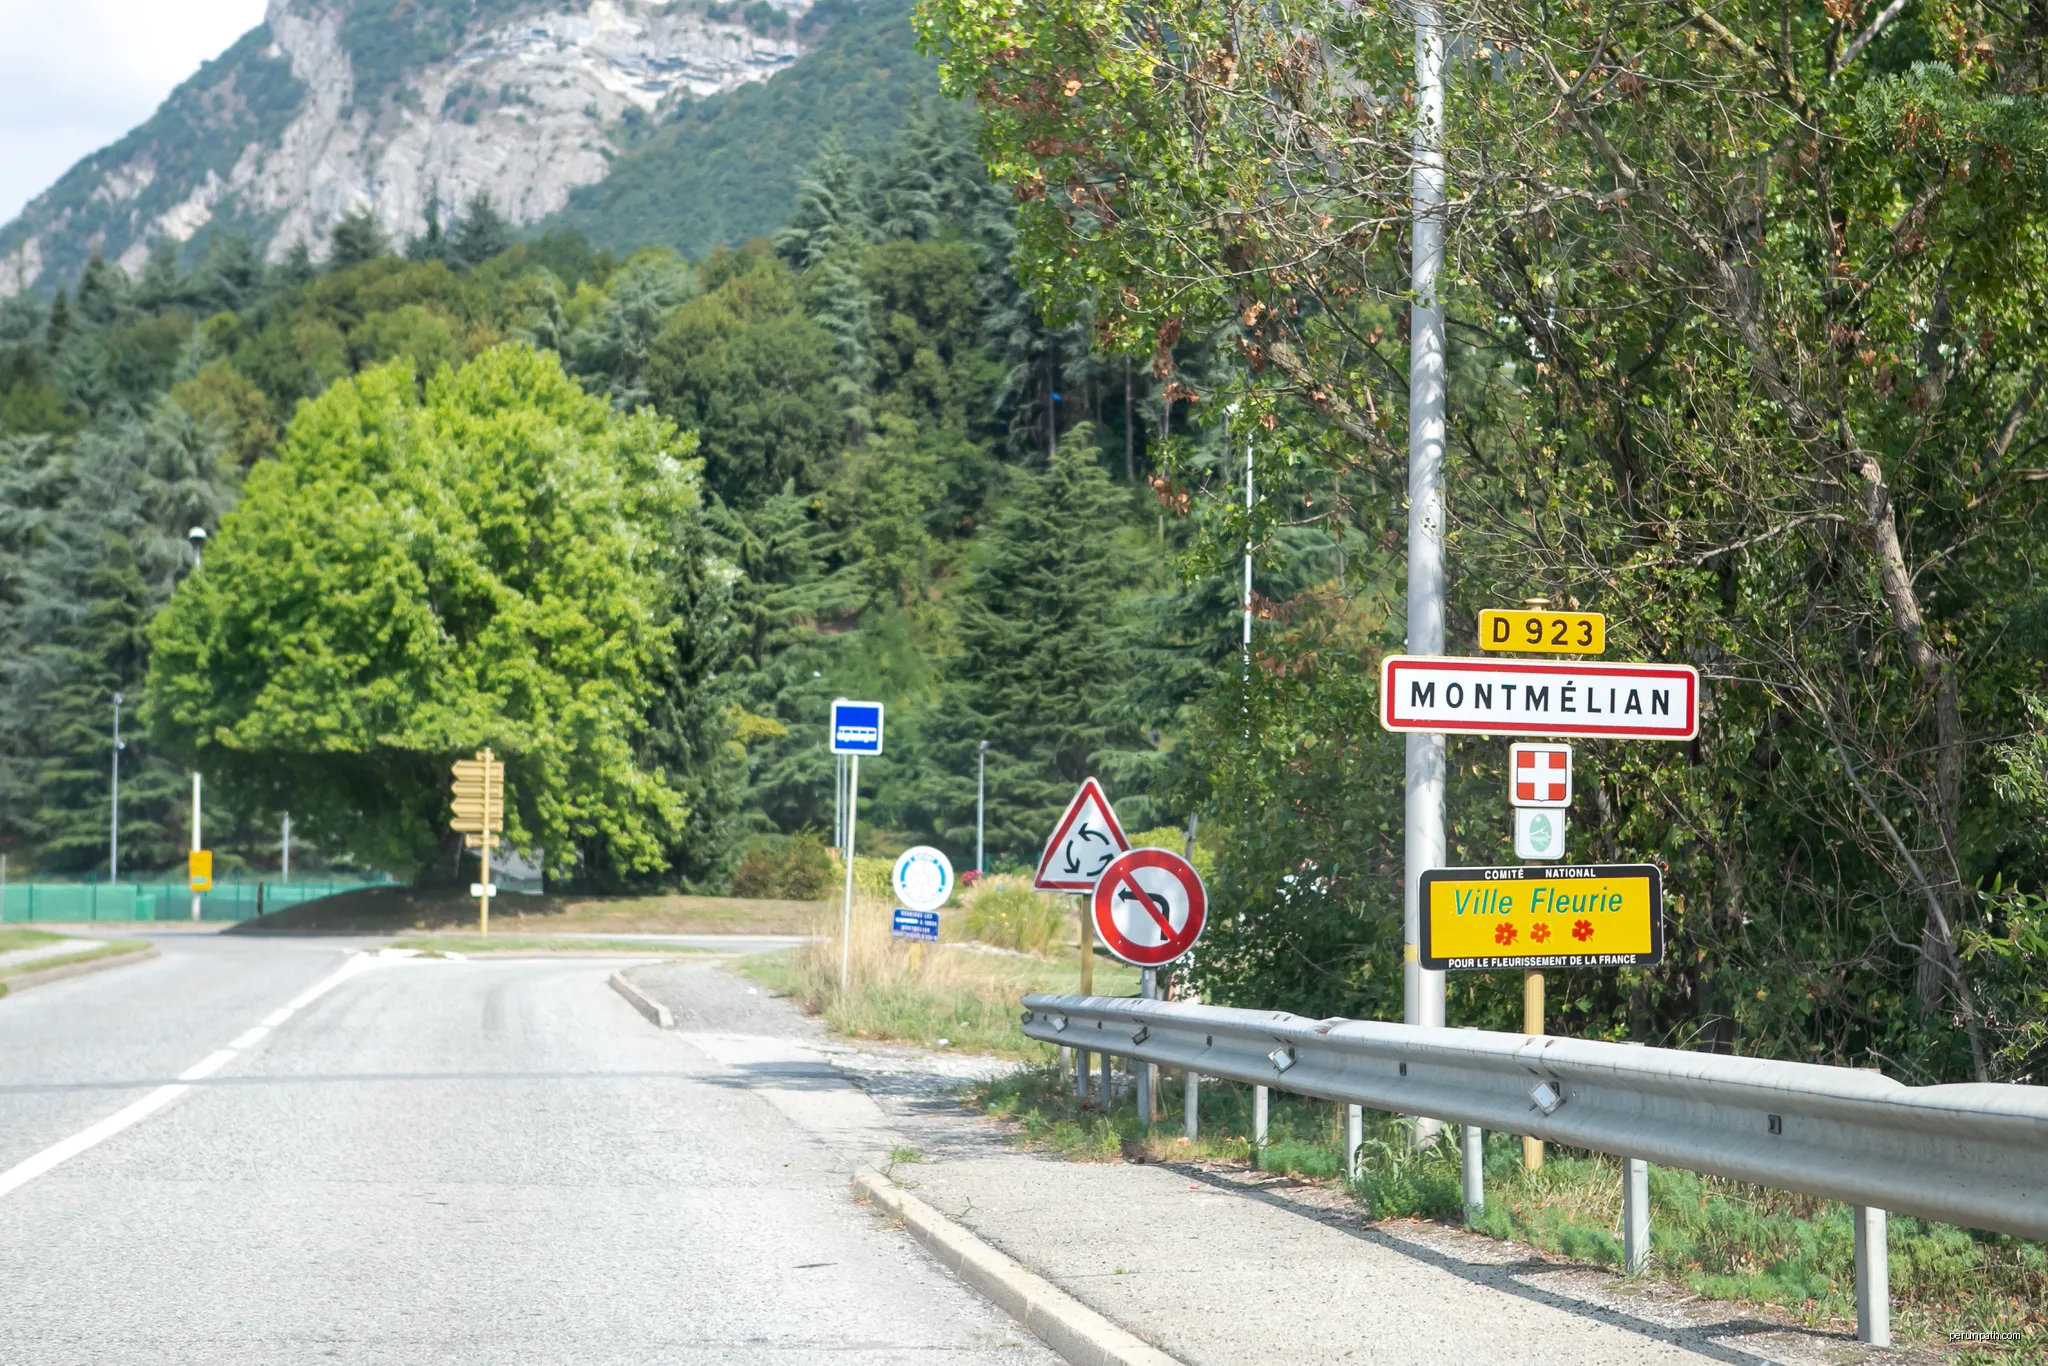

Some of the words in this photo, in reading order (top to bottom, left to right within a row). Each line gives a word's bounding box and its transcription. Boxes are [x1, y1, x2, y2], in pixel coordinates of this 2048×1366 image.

[1493, 617, 1510, 643] D
[1525, 618, 1593, 647] 923
[1411, 680, 1670, 716] MONTMÉLIAN
[1484, 867, 1524, 880] COMITÉ
[1545, 867, 1597, 879] NATIONAL
[1454, 887, 1513, 916] Ville
[1529, 886, 1623, 914] Fleurie
[1448, 957, 1475, 969] POUR
[1476, 957, 1489, 968] LE
[1491, 956, 1568, 968] FLEURISSEMENT
[1569, 955, 1583, 966] DE
[1584, 955, 1598, 966] LA
[1599, 954, 1636, 966] FRANCE
